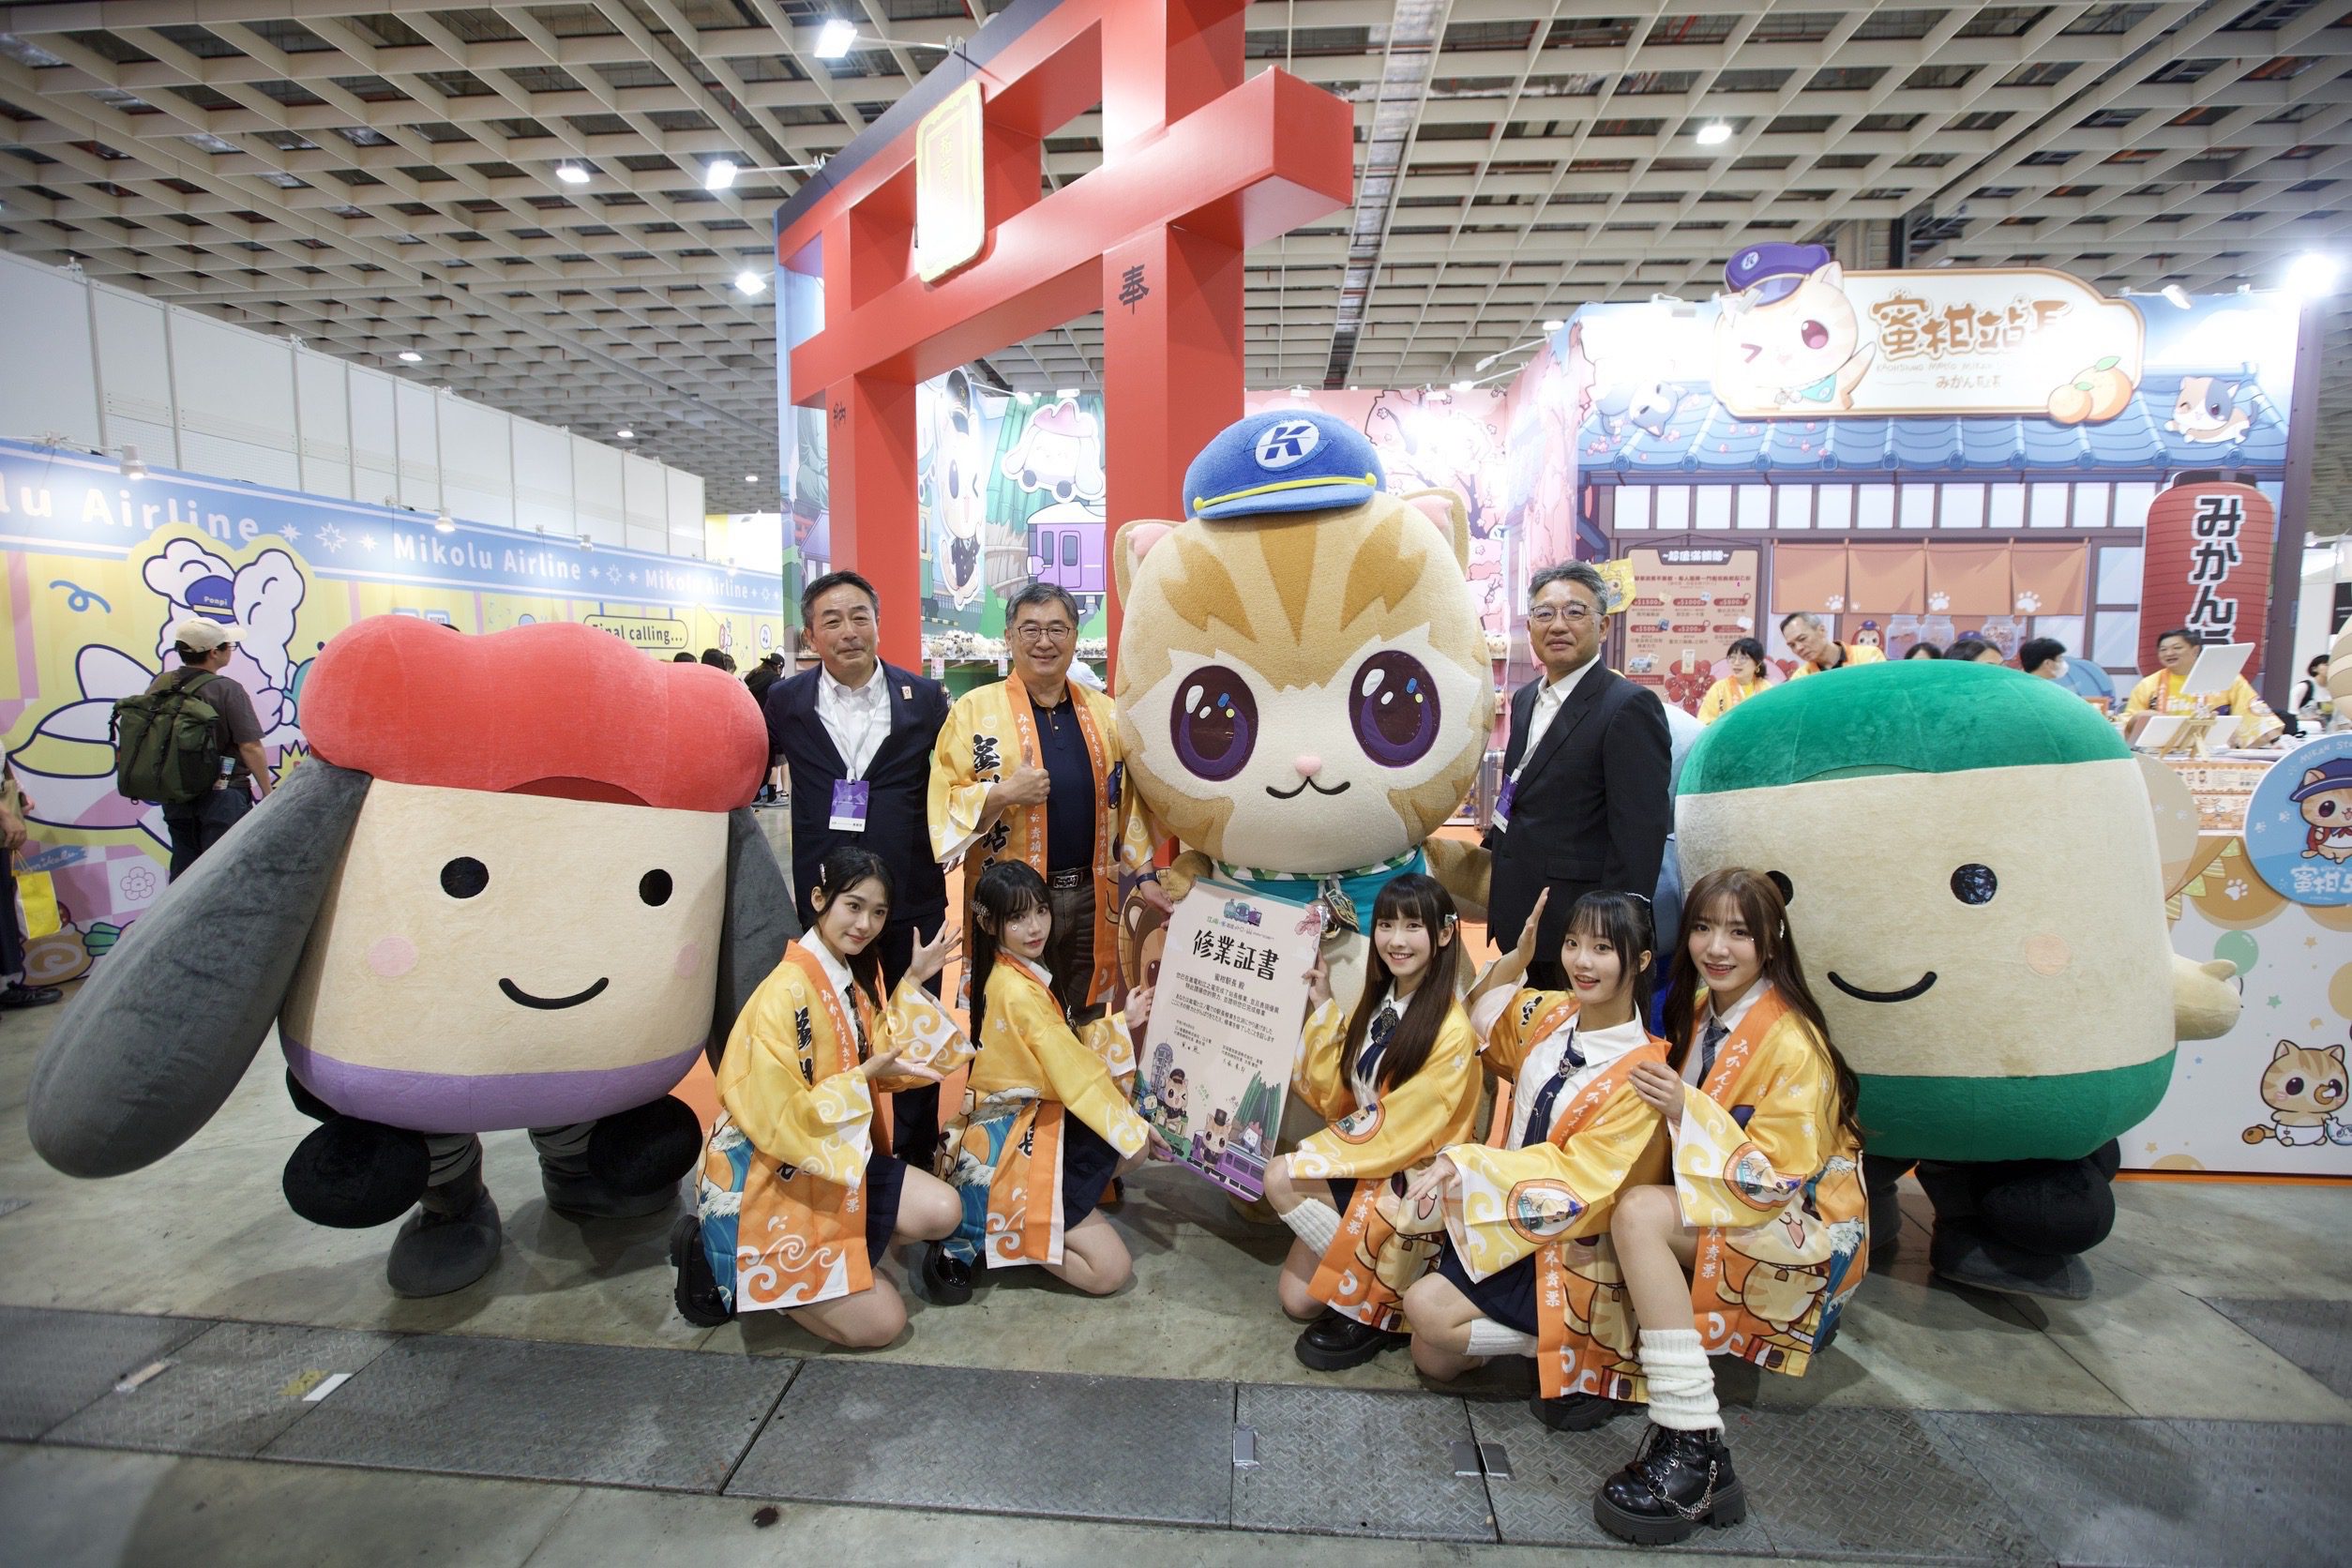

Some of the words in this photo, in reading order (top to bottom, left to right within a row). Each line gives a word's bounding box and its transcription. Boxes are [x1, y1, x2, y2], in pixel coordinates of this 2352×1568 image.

[1118, 264, 1150, 316] 奉
[82, 486, 260, 543] Airline
[393, 532, 492, 571] Mikolu
[503, 548, 581, 580] Airline
[204, 596, 228, 606] Ponpi
[704, 574, 749, 599] Airline
[629, 626, 683, 645] calling...
[1192, 928, 1279, 982] 修業証書
